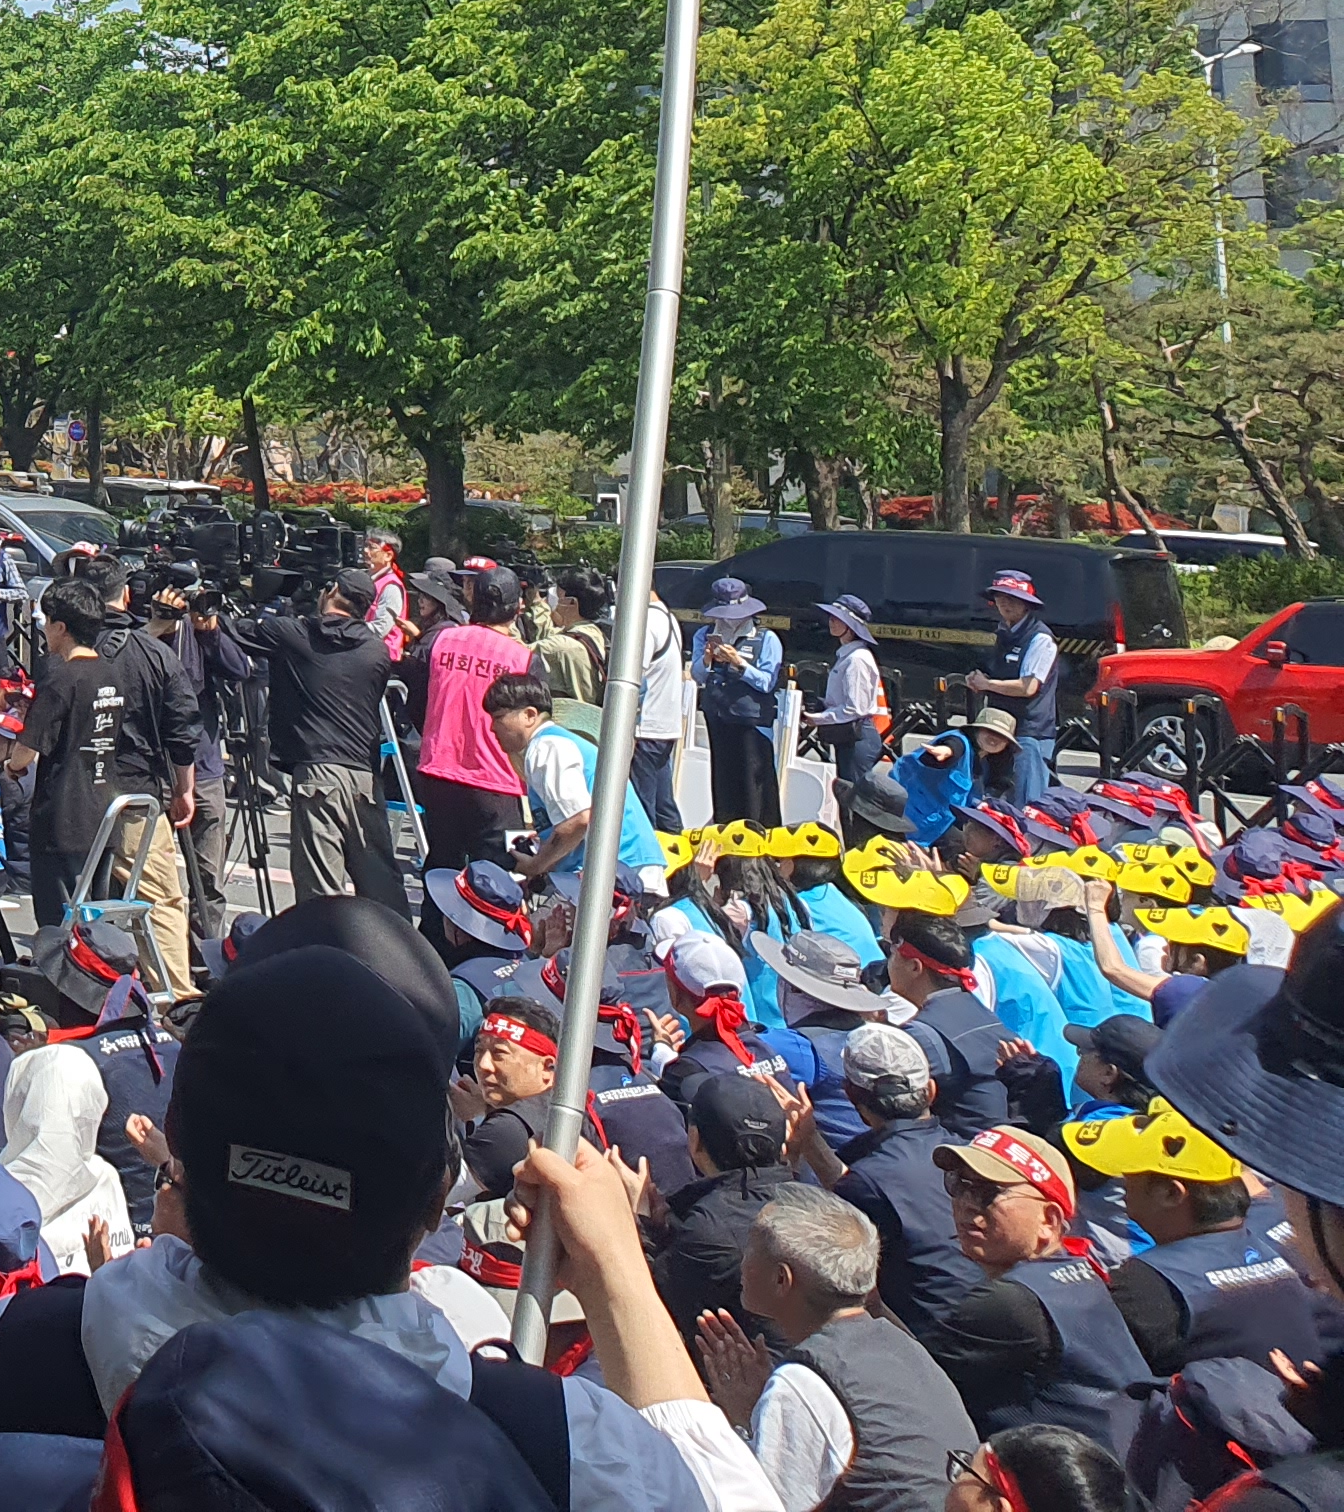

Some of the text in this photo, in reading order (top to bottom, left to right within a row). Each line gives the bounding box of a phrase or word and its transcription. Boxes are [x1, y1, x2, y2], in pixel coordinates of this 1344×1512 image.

[916, 629, 942, 640] TAXI
[231, 1151, 348, 1201] Titleist
[1004, 1142, 1052, 1183] 투쟁
